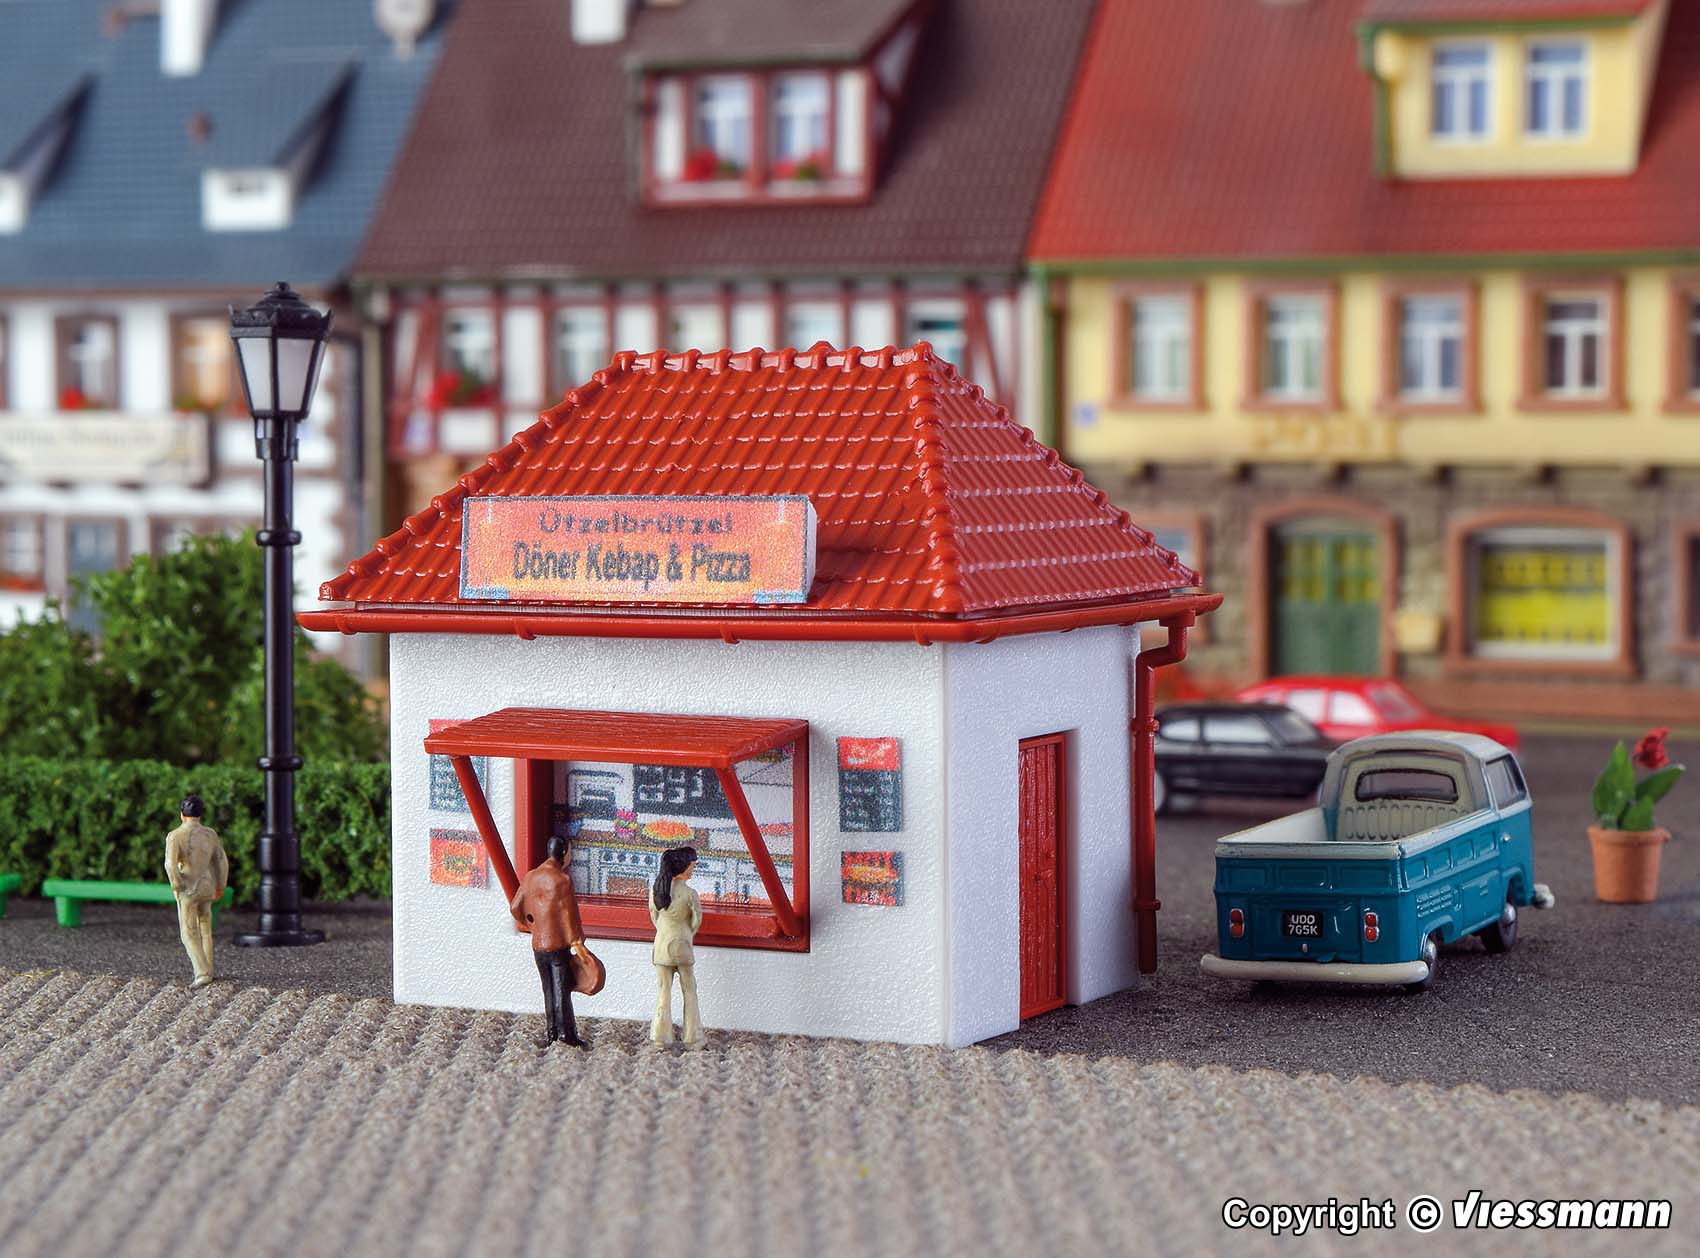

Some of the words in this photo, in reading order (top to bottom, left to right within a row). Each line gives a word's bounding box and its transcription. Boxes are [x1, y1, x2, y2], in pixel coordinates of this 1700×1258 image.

[513, 540, 580, 580] Döner
[585, 541, 659, 591] Kebap
[665, 542, 682, 581] &
[691, 542, 750, 582] Pizza
[1288, 924, 1319, 936] 765K
